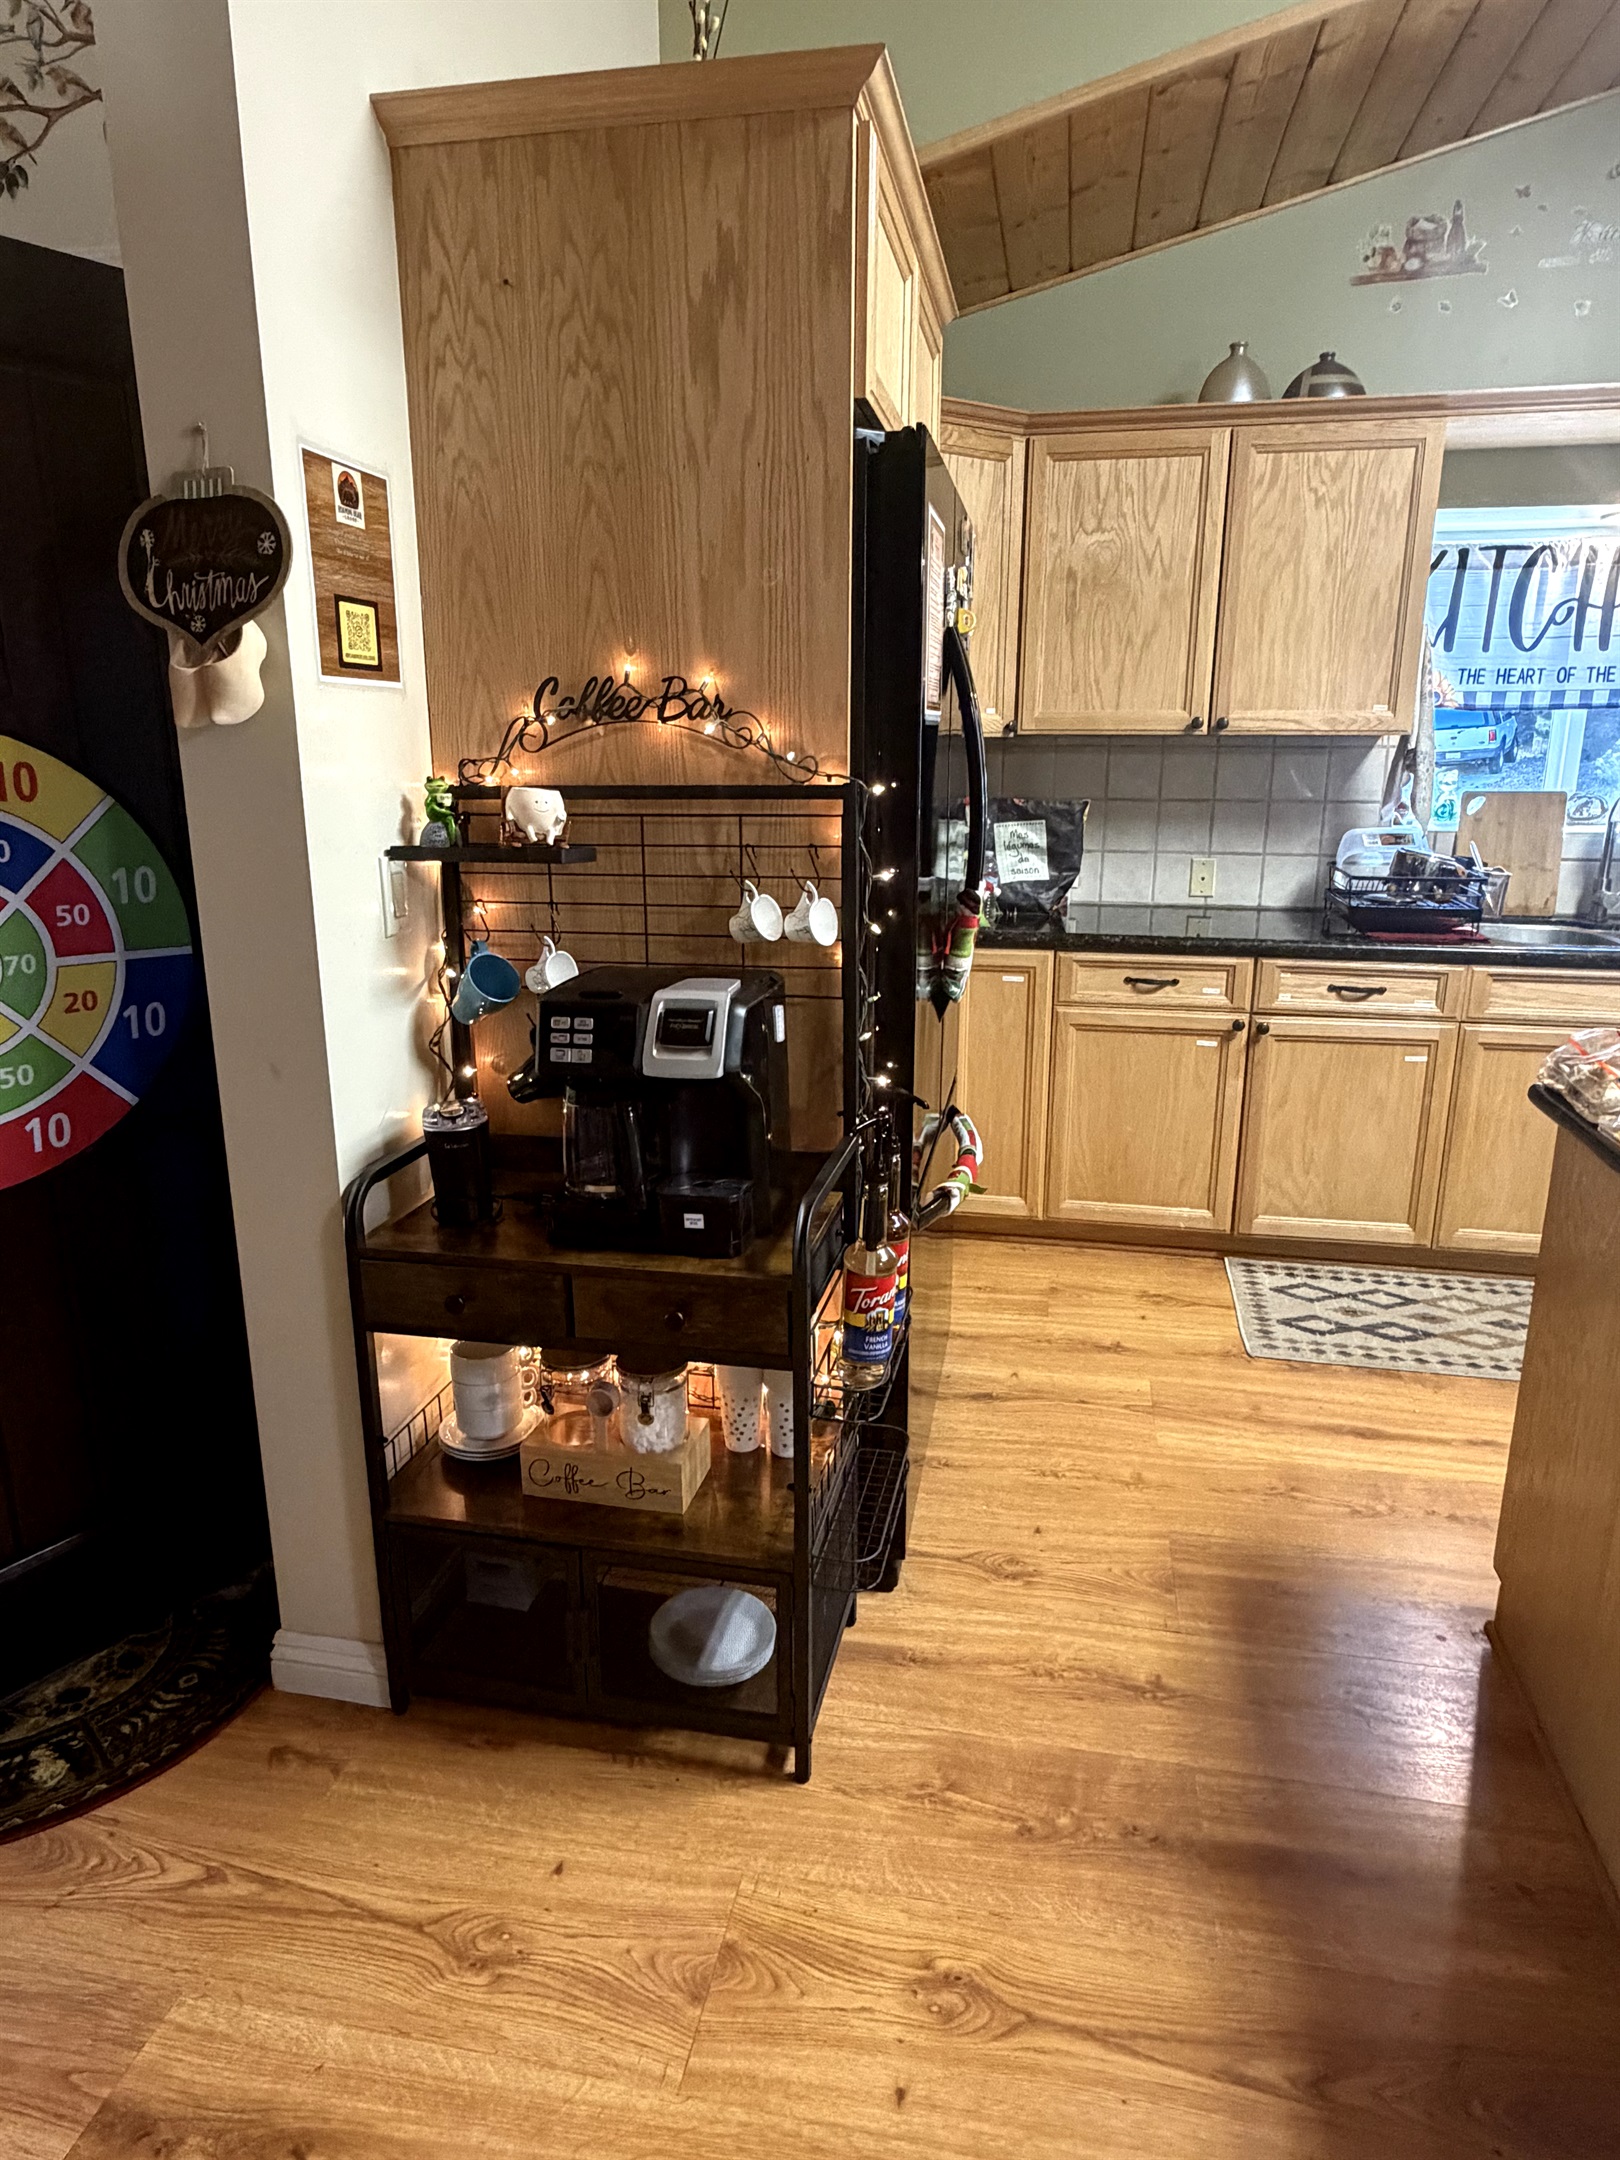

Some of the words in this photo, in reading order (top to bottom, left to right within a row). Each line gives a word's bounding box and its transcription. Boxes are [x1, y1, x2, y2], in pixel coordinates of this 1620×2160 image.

[147, 556, 270, 616] Christmas
[1458, 667, 1487, 685] THE
[1495, 667, 1547, 685] HEART
[1556, 666, 1578, 683] OF
[1586, 665, 1617, 683] THE
[533, 676, 650, 723] Coffee
[656, 675, 733, 723] Bar
[111, 865, 157, 905] 10
[55, 903, 91, 927] 50
[3, 953, 36, 976] 70
[63, 990, 99, 1014] 20
[122, 1001, 166, 1040] 10
[0, 1064, 34, 1090] 50
[24, 1112, 72, 1153] 10
[864, 1341, 888, 1351] VANILLA
[865, 1334, 888, 1343] FRENCH
[528, 1458, 608, 1495] Coffee
[616, 1466, 672, 1500] Bar
